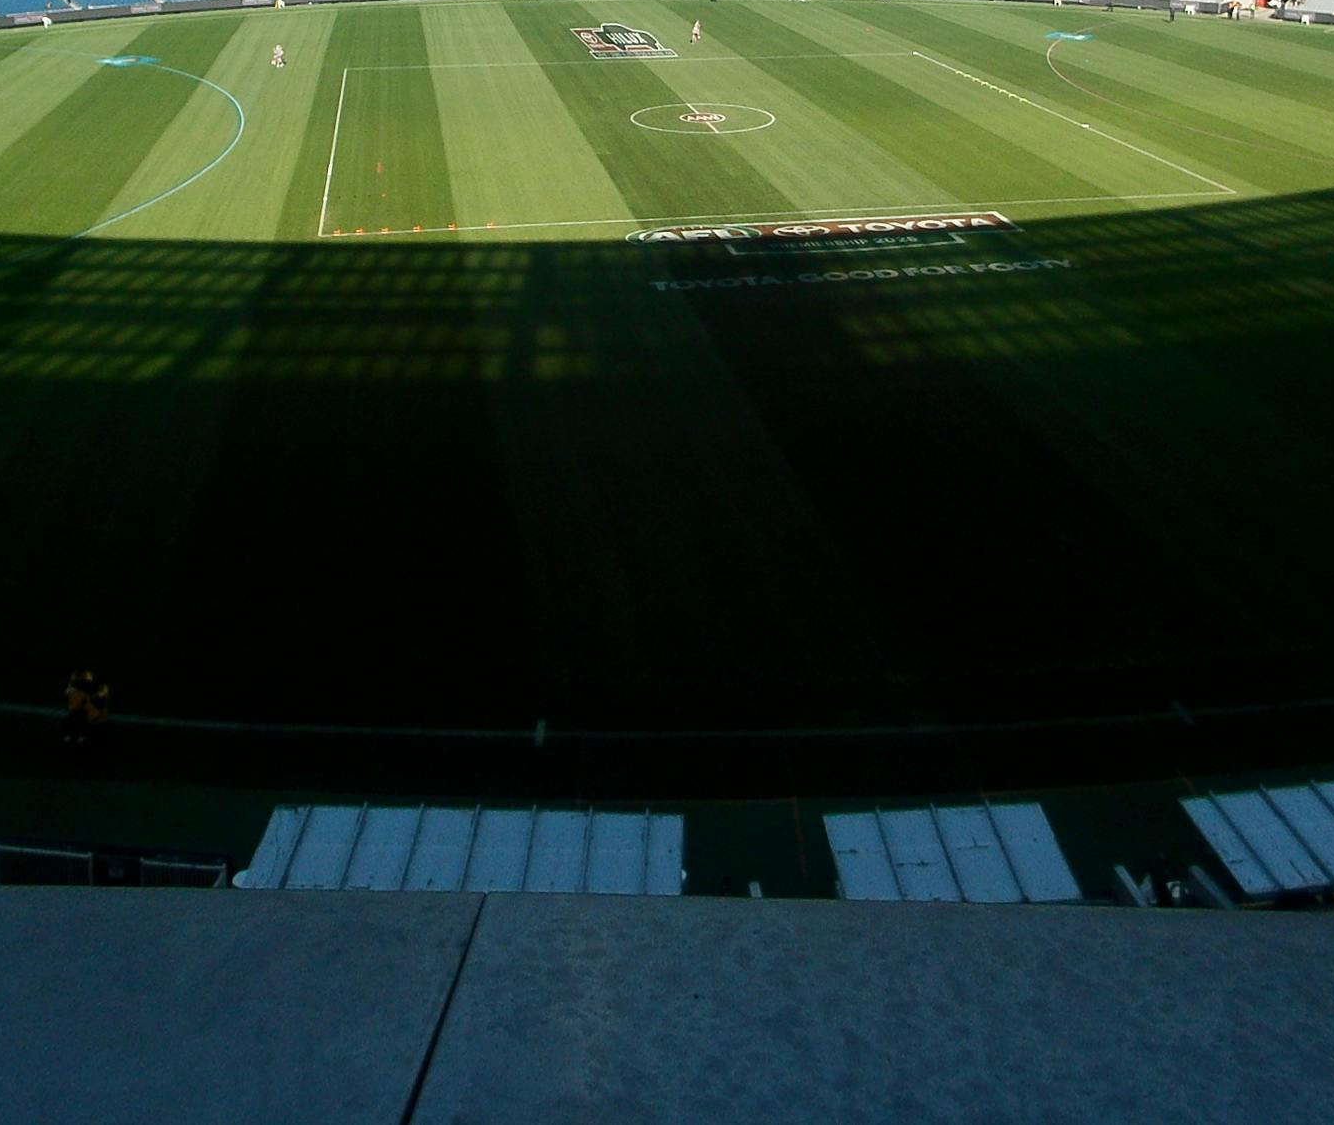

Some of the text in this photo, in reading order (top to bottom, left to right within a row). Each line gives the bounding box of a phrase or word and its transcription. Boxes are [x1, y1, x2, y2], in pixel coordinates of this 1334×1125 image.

[606, 33, 648, 44] HILUX
[644, 217, 996, 241] AFL TOYOTA
[798, 269, 899, 283] GOOD
[902, 264, 970, 277] FOR
[970, 259, 1071, 272] FOOTY
